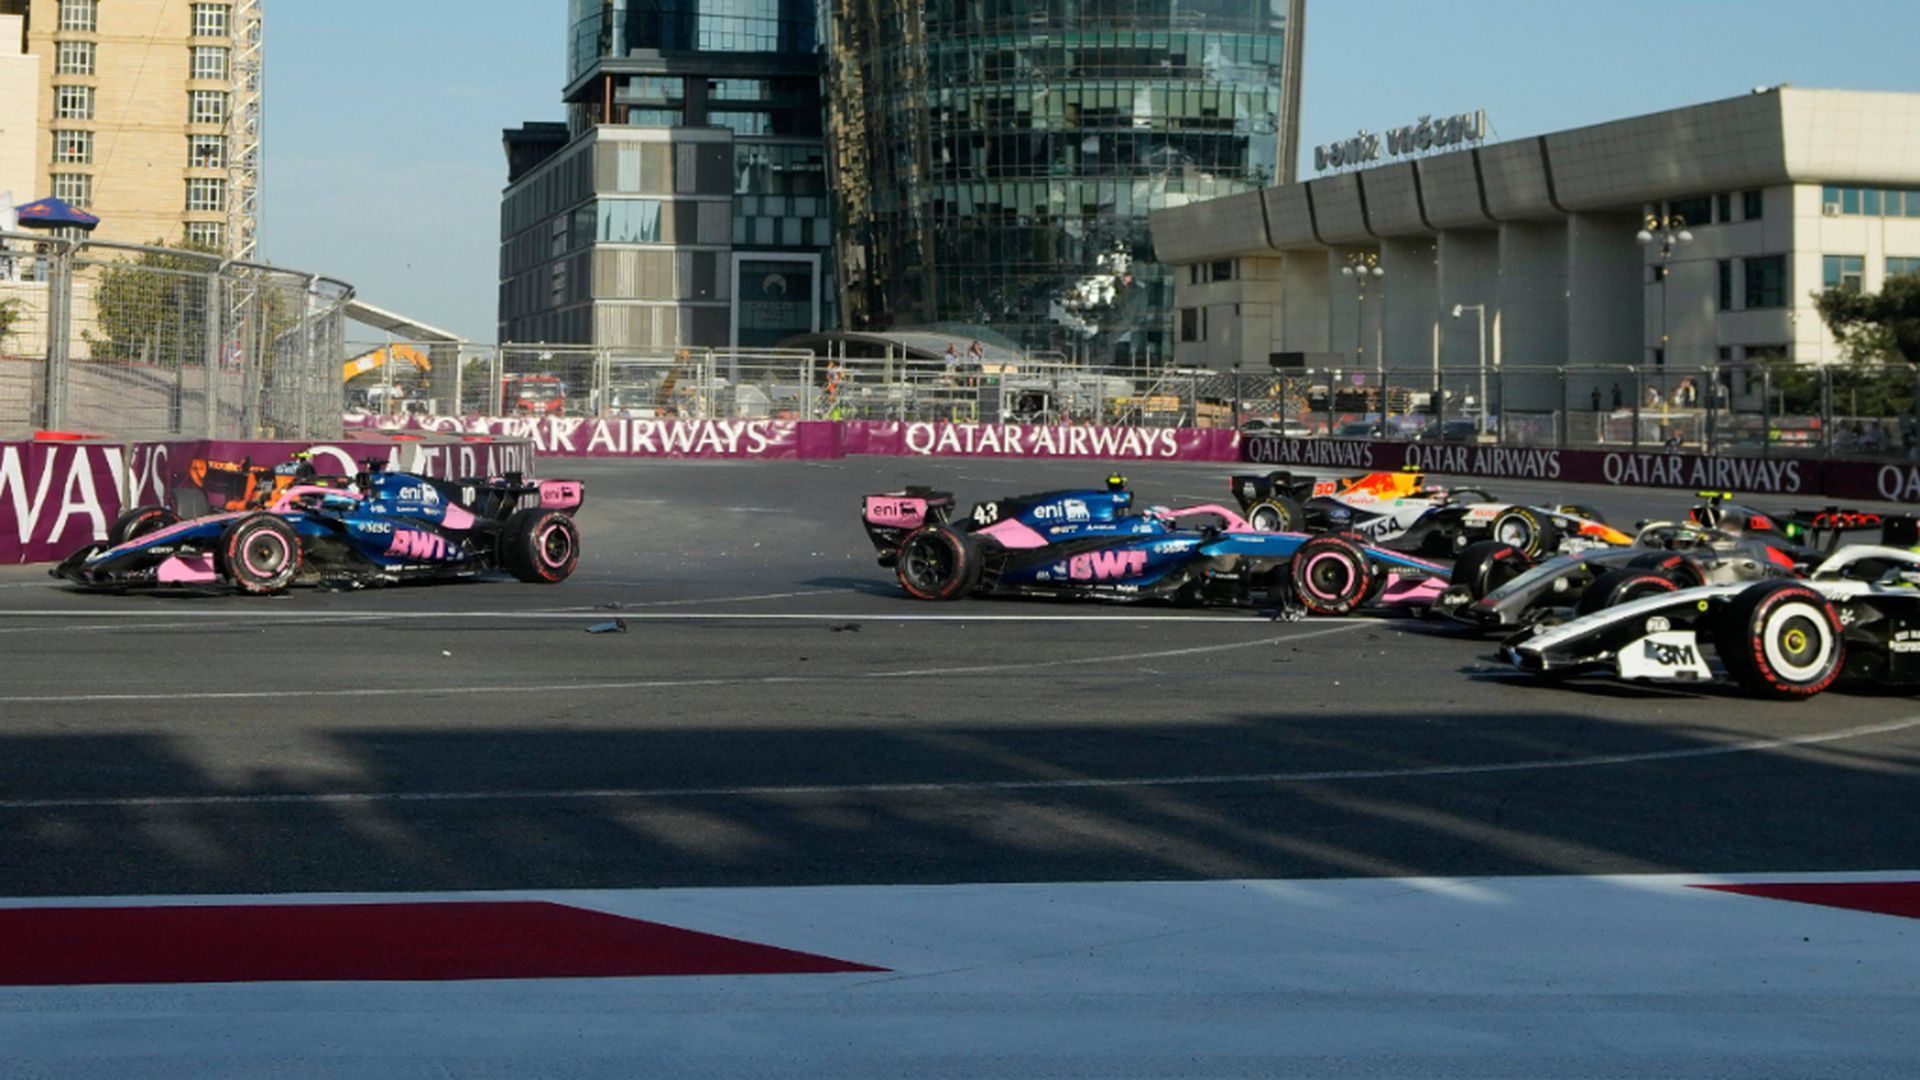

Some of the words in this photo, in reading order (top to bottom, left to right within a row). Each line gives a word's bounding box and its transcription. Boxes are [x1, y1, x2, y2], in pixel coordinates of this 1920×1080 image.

[587, 418, 768, 454] AIRWAYS
[905, 422, 1024, 455] QATAR
[1033, 424, 1178, 457] AIRWAYS
[1249, 437, 1300, 462] QATAR
[1304, 440, 1374, 467] AIRWAYS
[1405, 445, 1468, 471] QATAR
[1474, 448, 1561, 479] AIRWAYS
[1603, 452, 1683, 485] QATAR
[1690, 457, 1801, 493] AIRWAYS
[1876, 465, 1920, 501] QA
[400, 484, 421, 499] eni
[462, 486, 476, 507] 10
[1313, 481, 1337, 498] 30
[873, 502, 897, 516] eni
[973, 502, 998, 525] 43
[1033, 501, 1063, 519] eni
[1069, 550, 1147, 579] BWT
[1652, 644, 1696, 666] 3M
